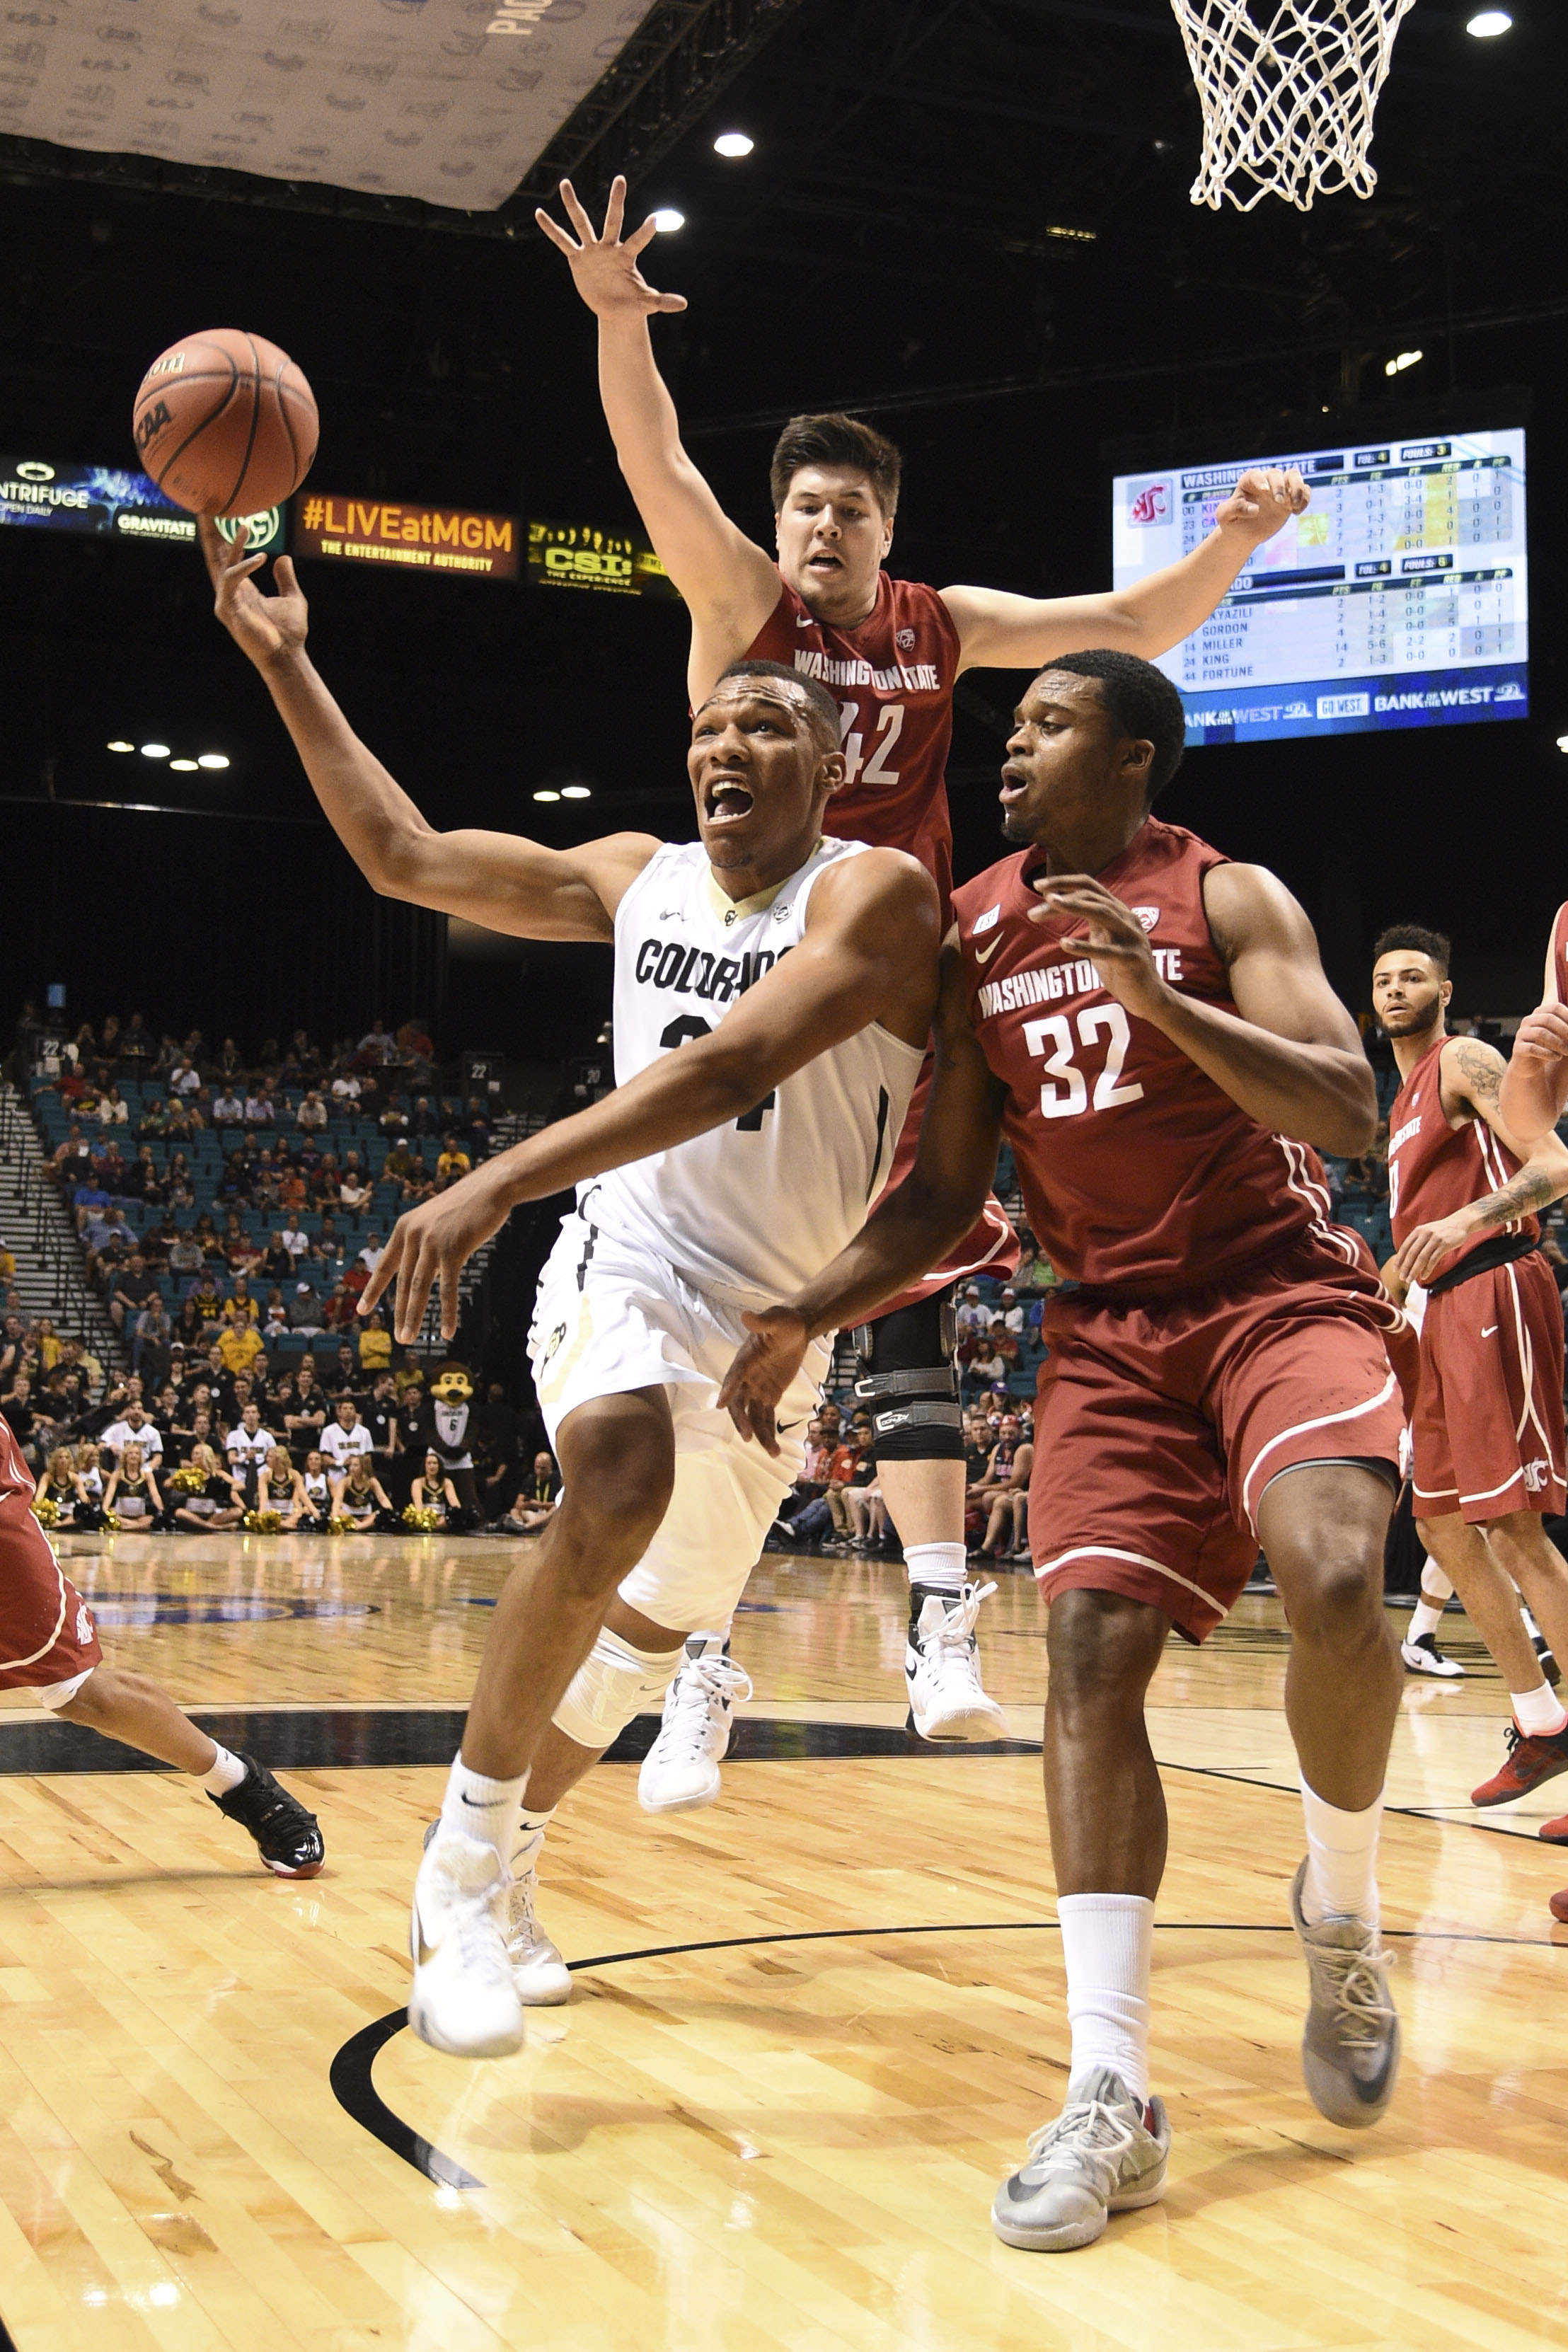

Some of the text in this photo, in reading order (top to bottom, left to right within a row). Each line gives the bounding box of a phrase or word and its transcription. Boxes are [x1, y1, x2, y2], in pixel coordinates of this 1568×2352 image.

[1378, 452, 1387, 462] 4
[1436, 444, 1447, 456] 3
[1331, 475, 1349, 485] PTS
[1367, 484, 1384, 494] 1-3
[1404, 479, 1422, 489] 0-0
[1447, 476, 1453, 486] 2
[1472, 473, 1480, 483] 0
[1494, 485, 1501, 495] 0
[26, 504, 53, 517] DAILY
[1404, 508, 1422, 519] 0-0
[1447, 505, 1453, 514] 4
[1472, 502, 1480, 513] 0
[1494, 500, 1501, 510] 0
[117, 514, 197, 537] GRAVITATE
[303, 497, 512, 552] #LIVEatMGM
[1447, 520, 1453, 531] 0
[1473, 518, 1480, 528] 0
[1405, 538, 1423, 549] 0-0
[1473, 532, 1480, 543] 0
[321, 539, 493, 572] THE ENTERTAINMENT AUTHORITY
[1380, 562, 1389, 572] 4
[546, 569, 631, 587] THE EXPERIENCE
[1332, 585, 1351, 595] PTS
[1337, 598, 1344, 608] 2
[1368, 595, 1385, 605] 1-2
[1405, 590, 1424, 601] 0-0
[1474, 584, 1481, 594] 0
[1495, 583, 1502, 593] 0
[1203, 623, 1248, 636] GORDON
[1337, 613, 1344, 623] 2
[1405, 605, 1424, 616] 0-0
[1448, 602, 1455, 612] 2
[1475, 600, 1482, 610] 0
[1203, 638, 1243, 651] MILLER
[1368, 623, 1385, 635] 2-2
[1406, 620, 1424, 630] 0-0
[1203, 654, 1229, 666] KING
[1335, 642, 1347, 652] 14
[1368, 639, 1385, 650] 5-6
[1407, 635, 1424, 645] 2-2
[1448, 633, 1455, 642] 2
[1475, 630, 1482, 640] 0
[1203, 667, 1254, 681] FORTUNE
[1338, 658, 1344, 668] 2
[1369, 654, 1386, 664] 1-3
[1406, 650, 1424, 661] 0-0
[1448, 647, 1455, 657] 0
[1475, 645, 1482, 655] 0
[1322, 701, 1334, 715] GO
[1374, 691, 1425, 712] BANK
[1426, 692, 1439, 701] OF
[1440, 686, 1494, 707] WEST
[1233, 706, 1284, 724] WEST
[635, 938, 797, 1003] COLORAD
[1022, 1003, 1144, 1119] 32
[471, 1064, 488, 1079] 22
